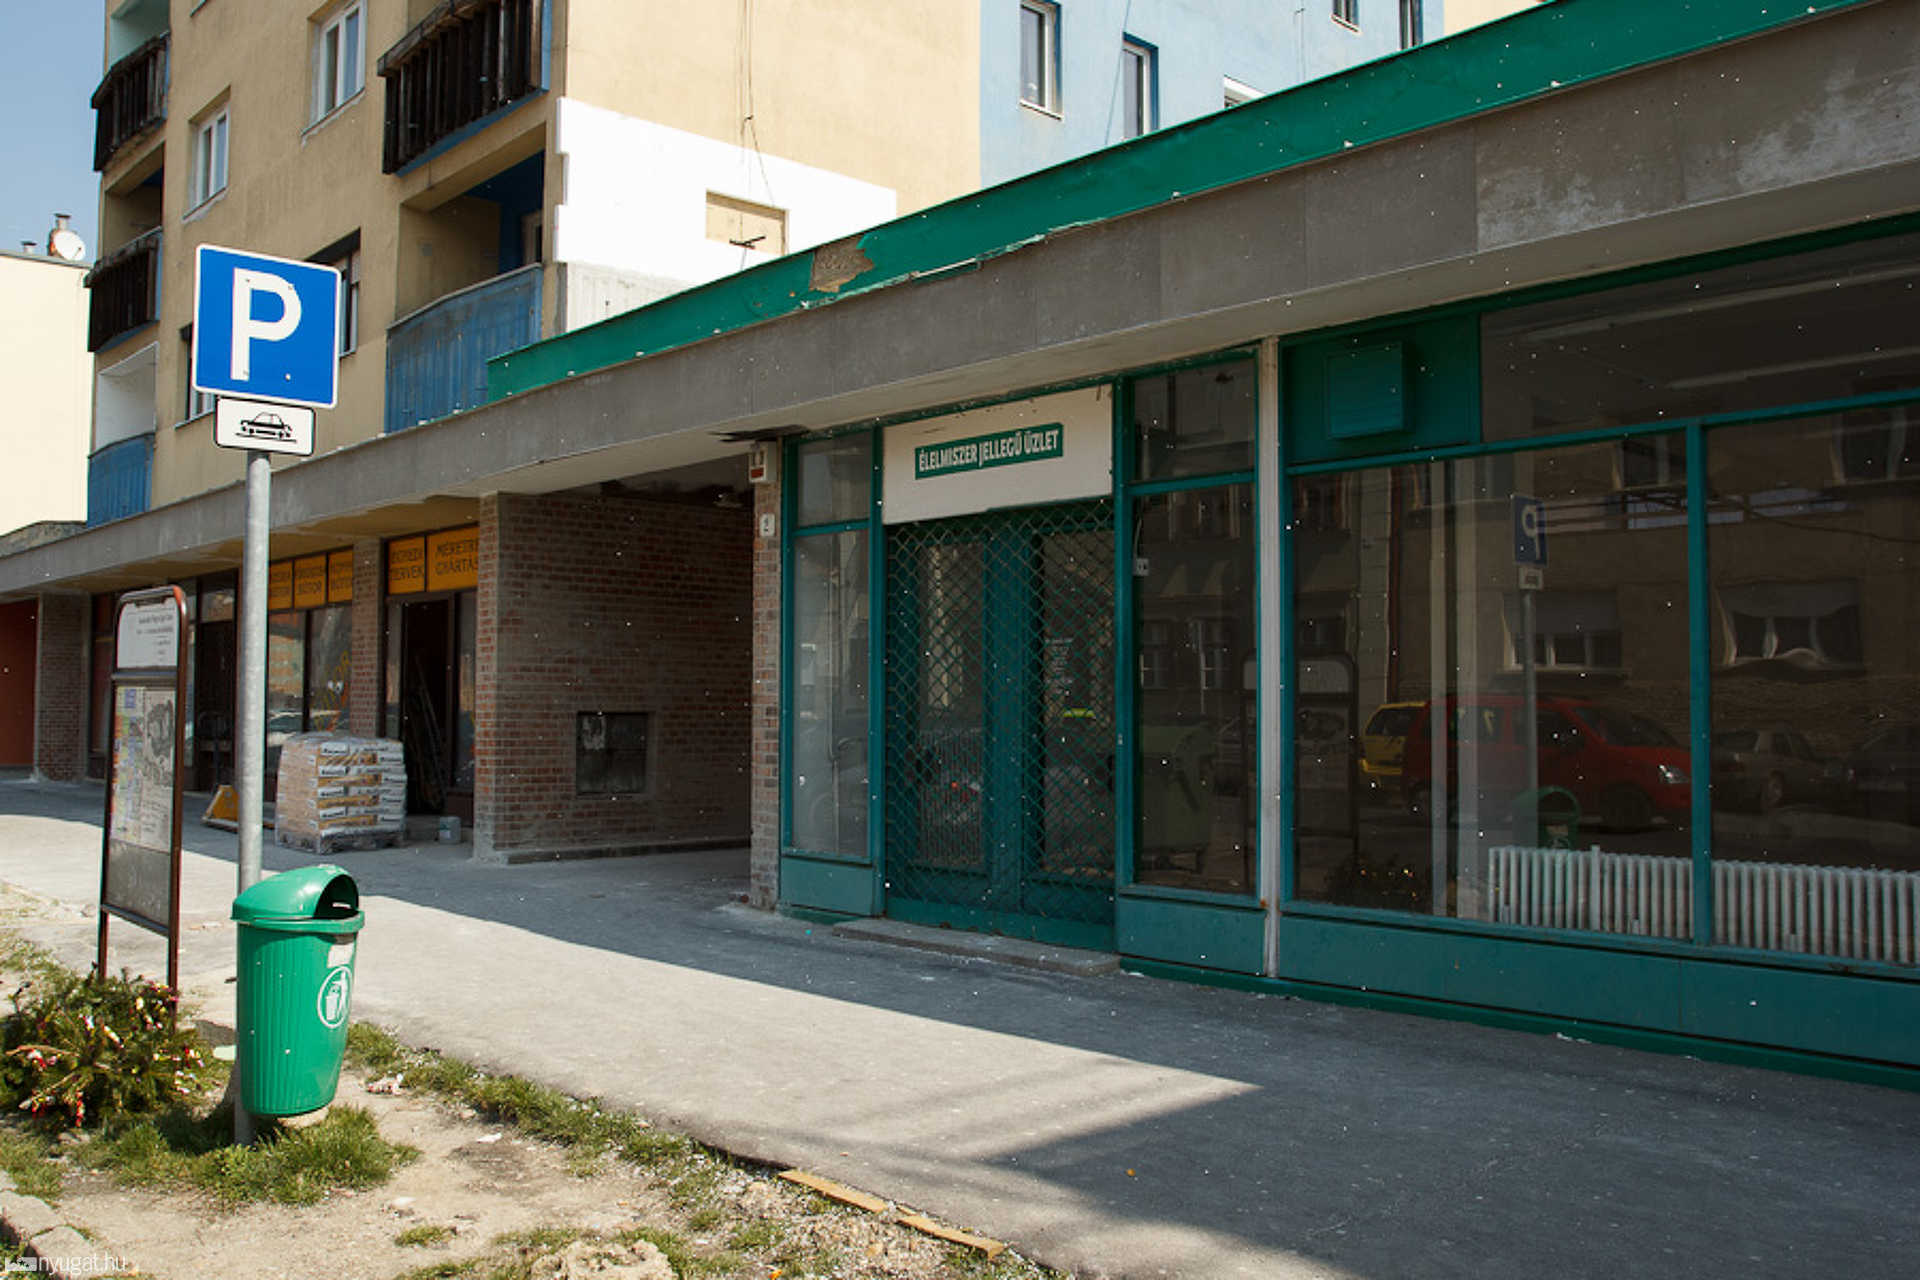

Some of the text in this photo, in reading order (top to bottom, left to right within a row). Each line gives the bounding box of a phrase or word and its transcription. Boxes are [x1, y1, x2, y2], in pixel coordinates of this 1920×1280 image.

[231, 267, 301, 381] P
[918, 430, 1059, 472] ÉLELMISZER JELLEGŰ ÜZLET
